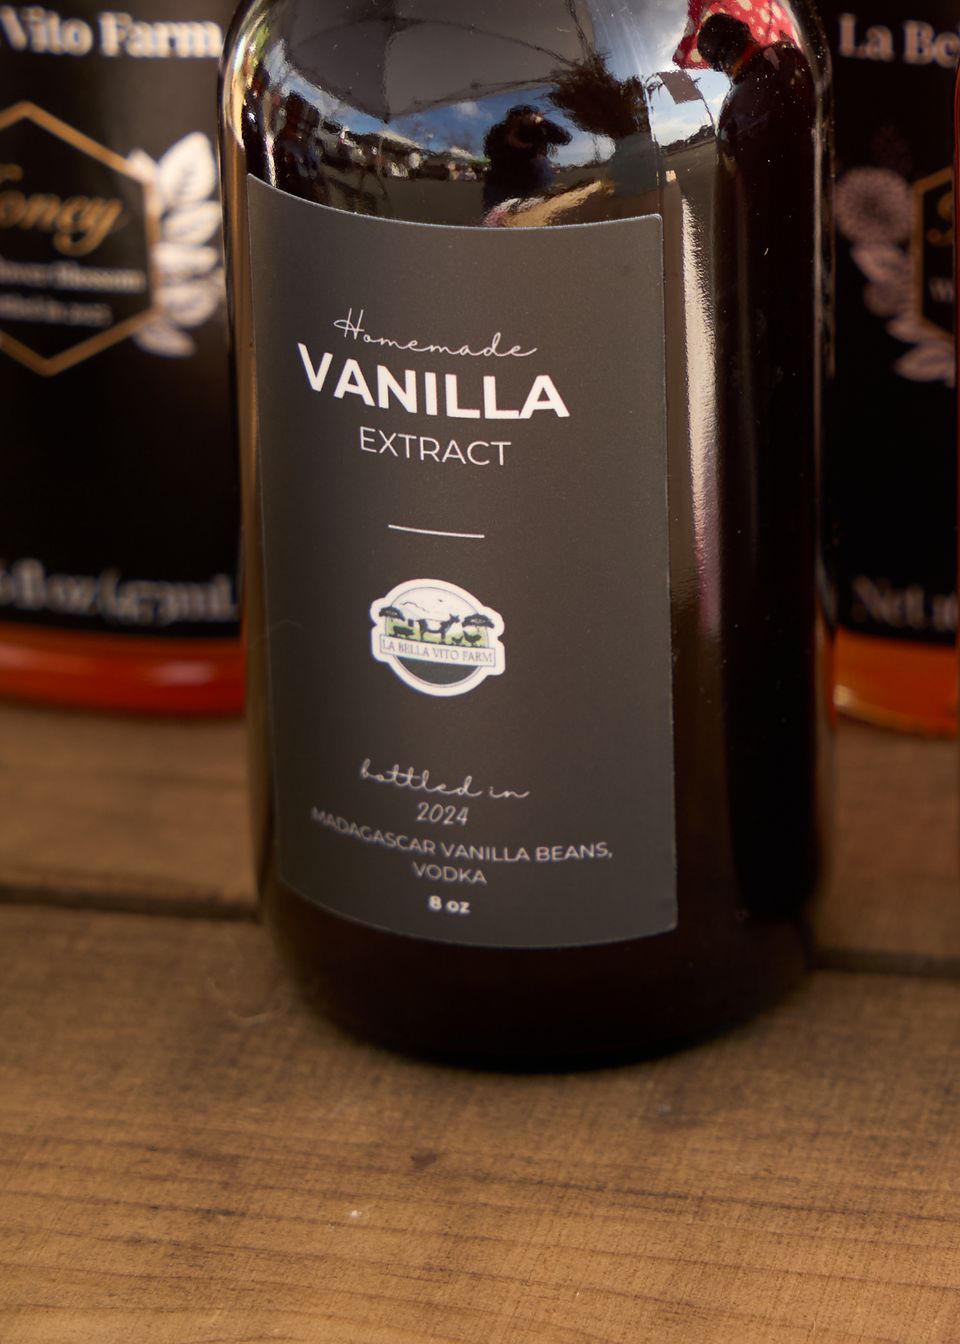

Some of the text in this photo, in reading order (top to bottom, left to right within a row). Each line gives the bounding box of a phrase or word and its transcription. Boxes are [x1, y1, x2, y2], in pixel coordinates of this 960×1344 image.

[100, 10, 224, 58] Farm
[839, 12, 895, 62] La
[333, 307, 538, 358] Homemade
[297, 341, 571, 420] VANILLA
[359, 425, 513, 467] EXTRACT
[382, 639, 494, 663] LA BELLA VITO FARM
[360, 757, 530, 799] bottled in
[310, 806, 613, 862] MADAGASCAR VANILLA BEANS,
[415, 802, 470, 826] 2024
[412, 861, 488, 885] VODKA
[428, 895, 471, 914] 8 oz
